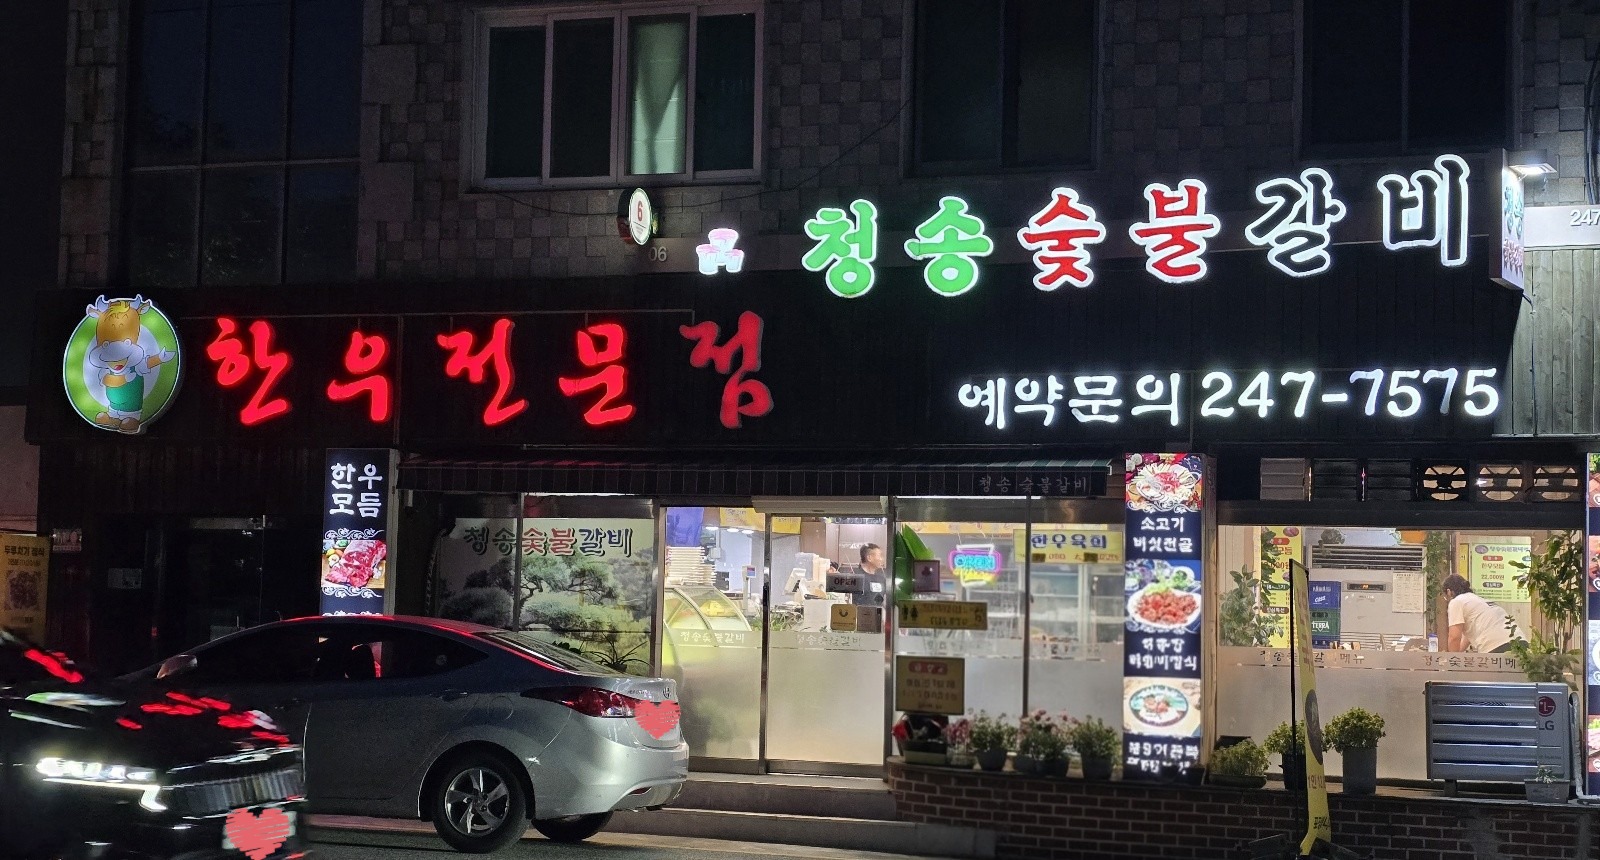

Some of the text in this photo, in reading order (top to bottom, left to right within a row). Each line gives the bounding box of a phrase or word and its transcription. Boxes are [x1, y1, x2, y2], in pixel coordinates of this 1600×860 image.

[637, 200, 644, 222] 6
[957, 366, 1500, 429] 예약문의 247-7575
[330, 462, 384, 490] 한우
[329, 492, 383, 519] 모듬
[1140, 516, 1185, 532] 소고기
[4, 545, 30, 556] 두루치기
[1133, 535, 1194, 553] 버섯전골
[834, 577, 857, 586] OPEN
[1311, 621, 1330, 630] TERRA
[1538, 719, 1555, 731] LG
